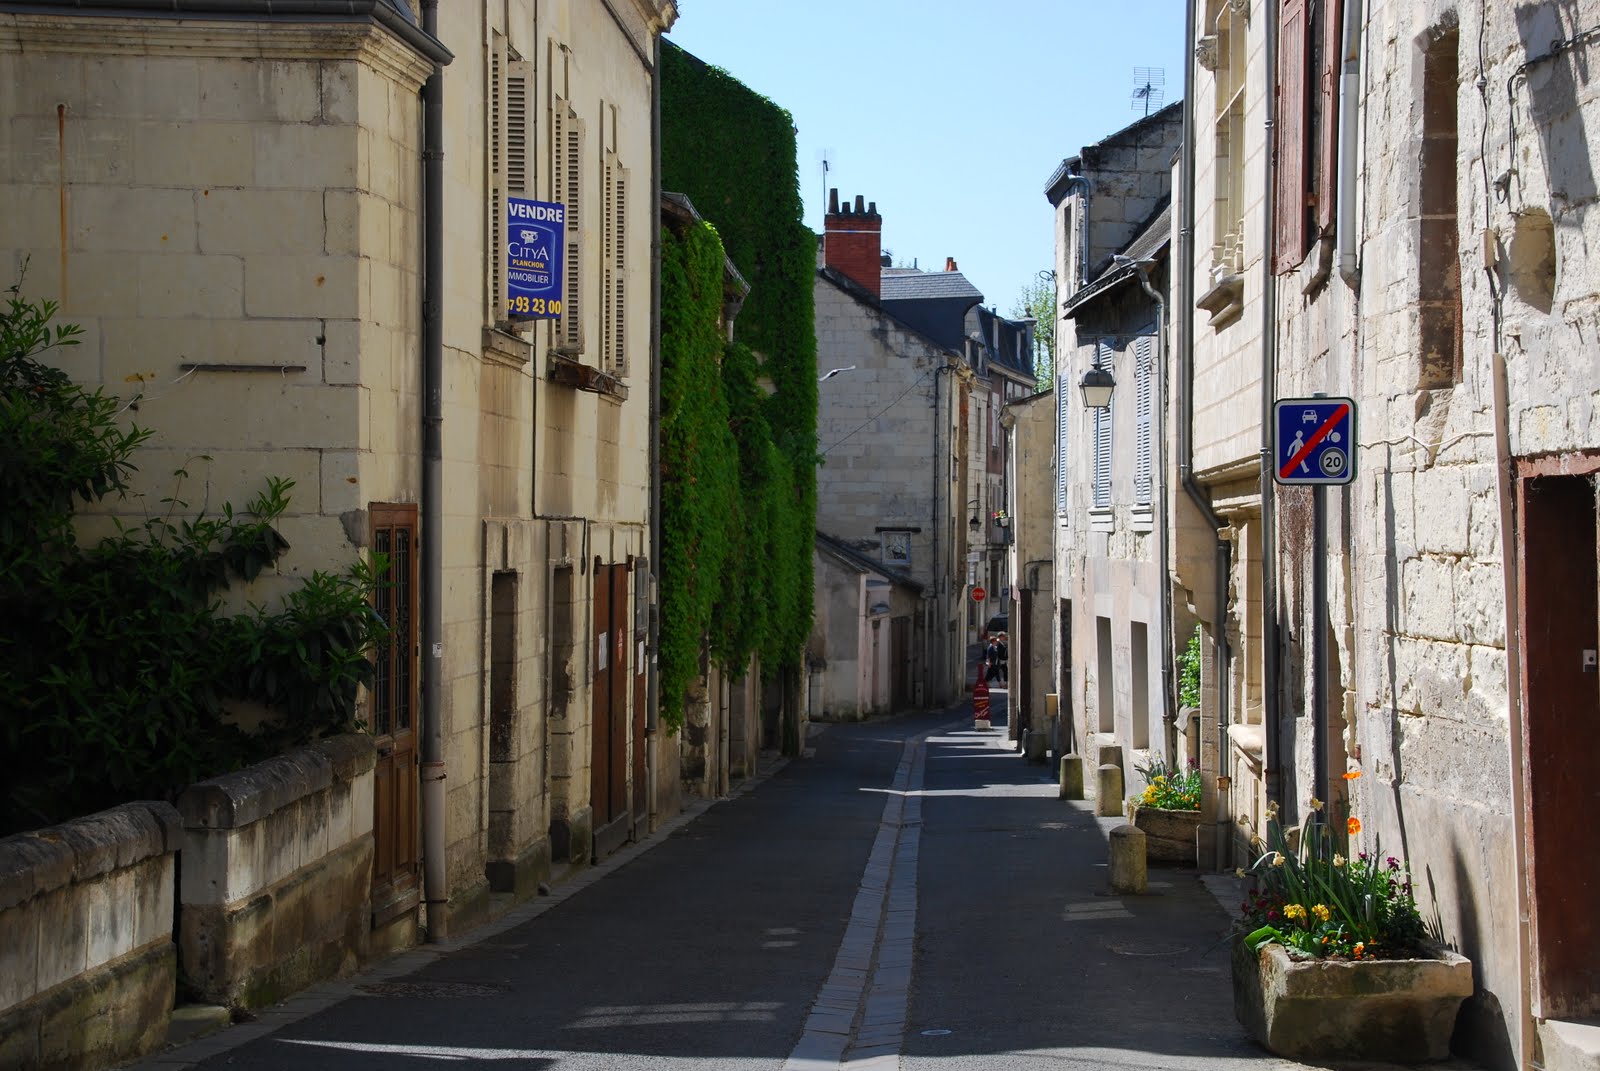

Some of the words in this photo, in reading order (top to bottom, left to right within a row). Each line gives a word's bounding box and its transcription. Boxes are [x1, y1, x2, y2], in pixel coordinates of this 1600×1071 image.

[508, 203, 563, 223] VENDRE
[512, 259, 545, 269] PLANCHON
[516, 296, 530, 313] 93
[532, 298, 546, 315] 23
[548, 300, 562, 314] 00
[1325, 456, 1341, 468] 20
